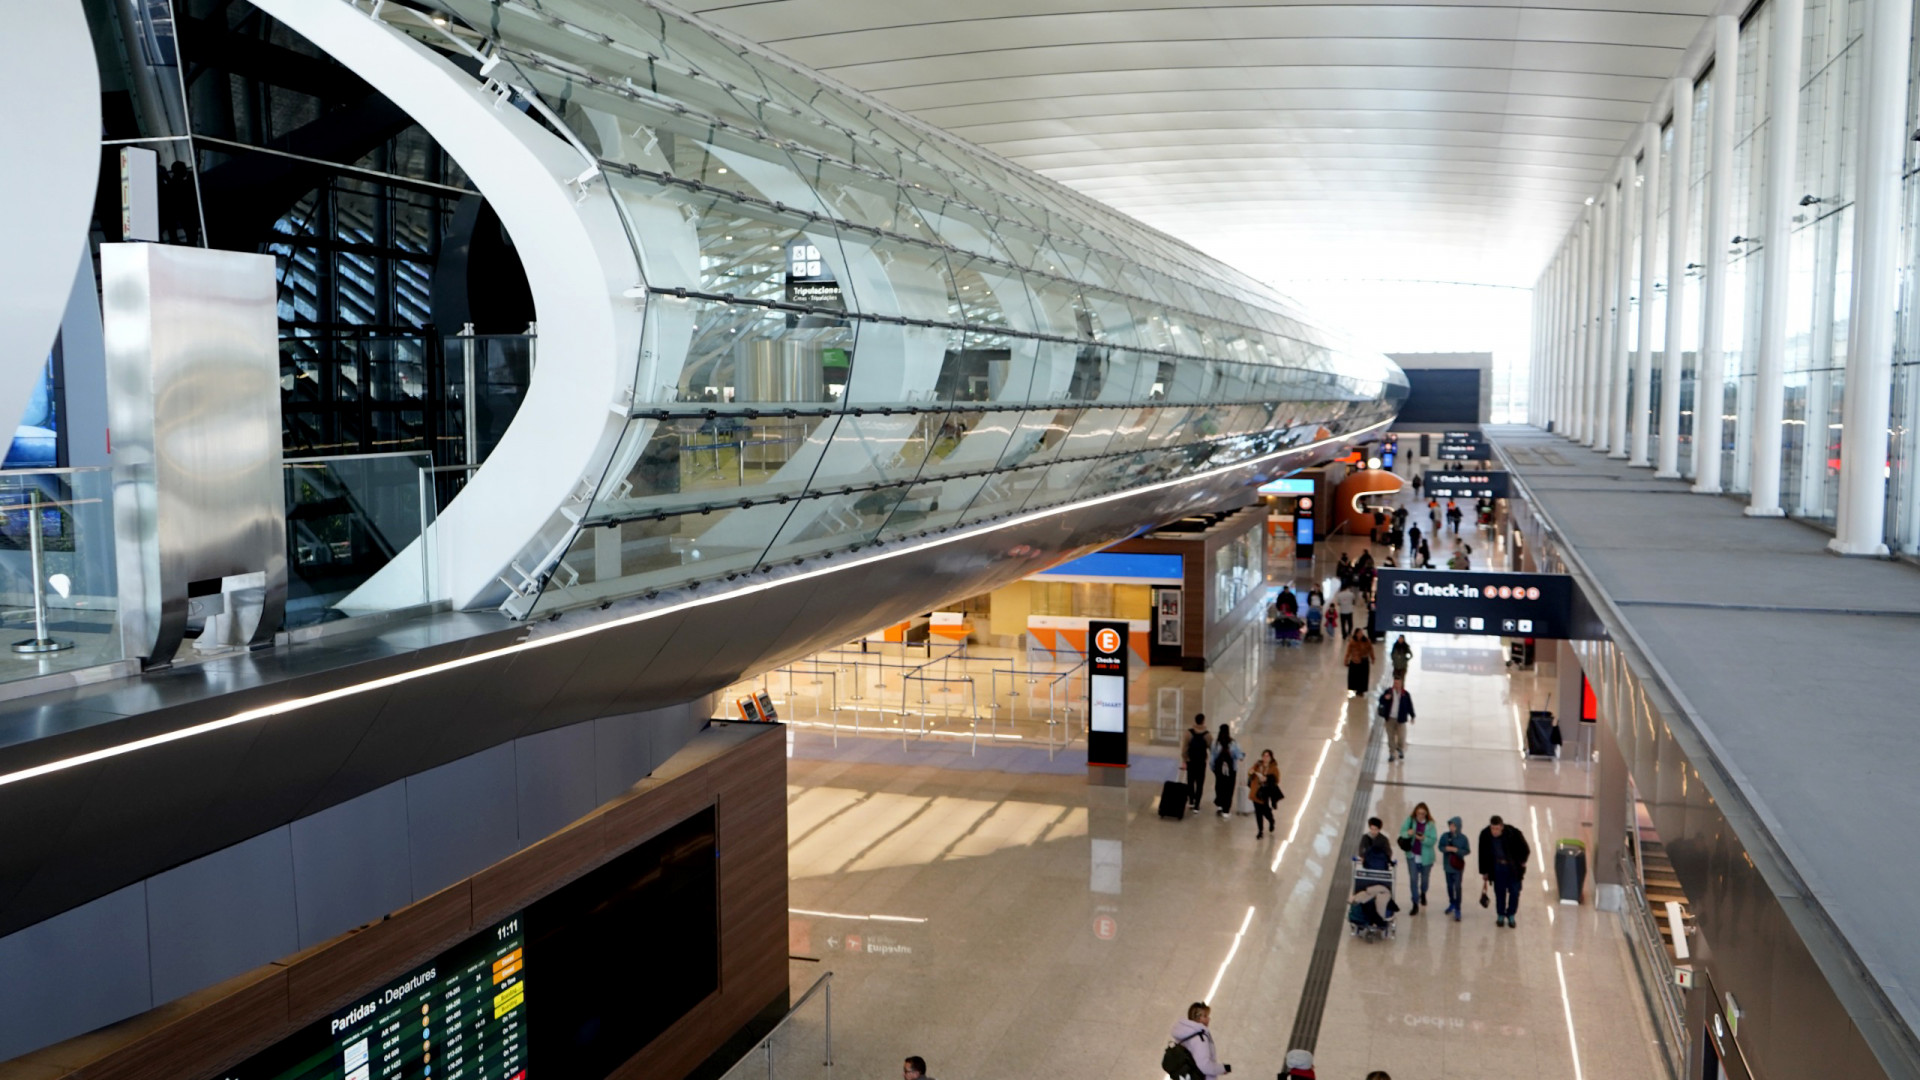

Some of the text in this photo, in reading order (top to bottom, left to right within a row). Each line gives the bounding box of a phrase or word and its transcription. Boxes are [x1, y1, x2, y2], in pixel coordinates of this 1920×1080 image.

[793, 286, 842, 297] Tripulaciones
[1413, 582, 1479, 598] Check-in
[1102, 632, 1114, 649] E
[1095, 656, 1120, 664] Check-in
[497, 919, 518, 941] 11:11
[331, 1000, 377, 1035] Partidas
[384, 967, 437, 1004] Departures
